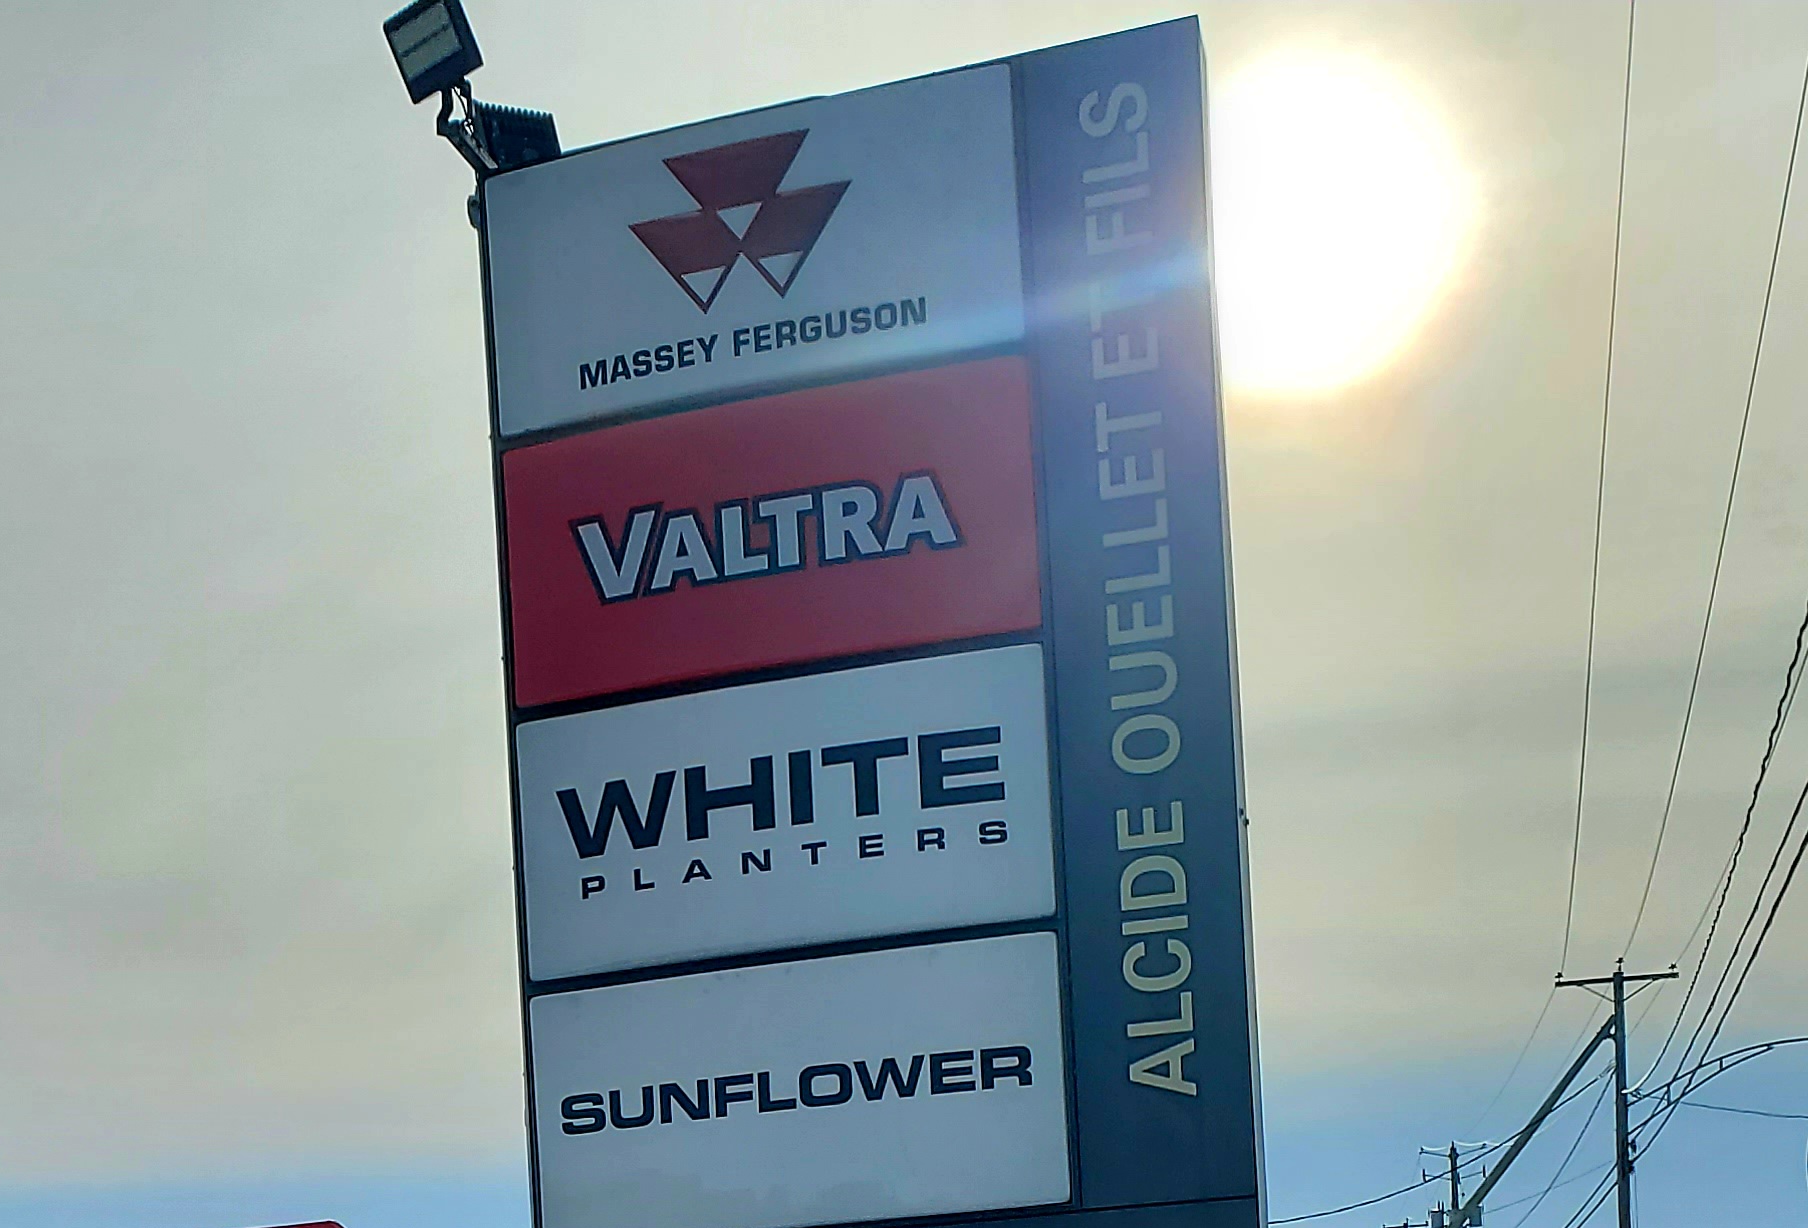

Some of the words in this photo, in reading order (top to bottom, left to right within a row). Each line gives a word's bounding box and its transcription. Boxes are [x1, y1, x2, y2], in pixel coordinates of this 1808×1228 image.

[1079, 82, 1153, 256] FILS
[579, 334, 718, 390] MASSEY
[733, 297, 927, 357] FERGUSON
[1089, 281, 1160, 380] ET
[572, 471, 964, 602] VALTRA
[1095, 401, 1181, 776] OUELLET
[556, 726, 1006, 859] WHITE
[580, 820, 1008, 900] PLANTERS
[1117, 800, 1198, 1096] ALCIDE
[561, 1045, 1033, 1135] SUNFLOWER
